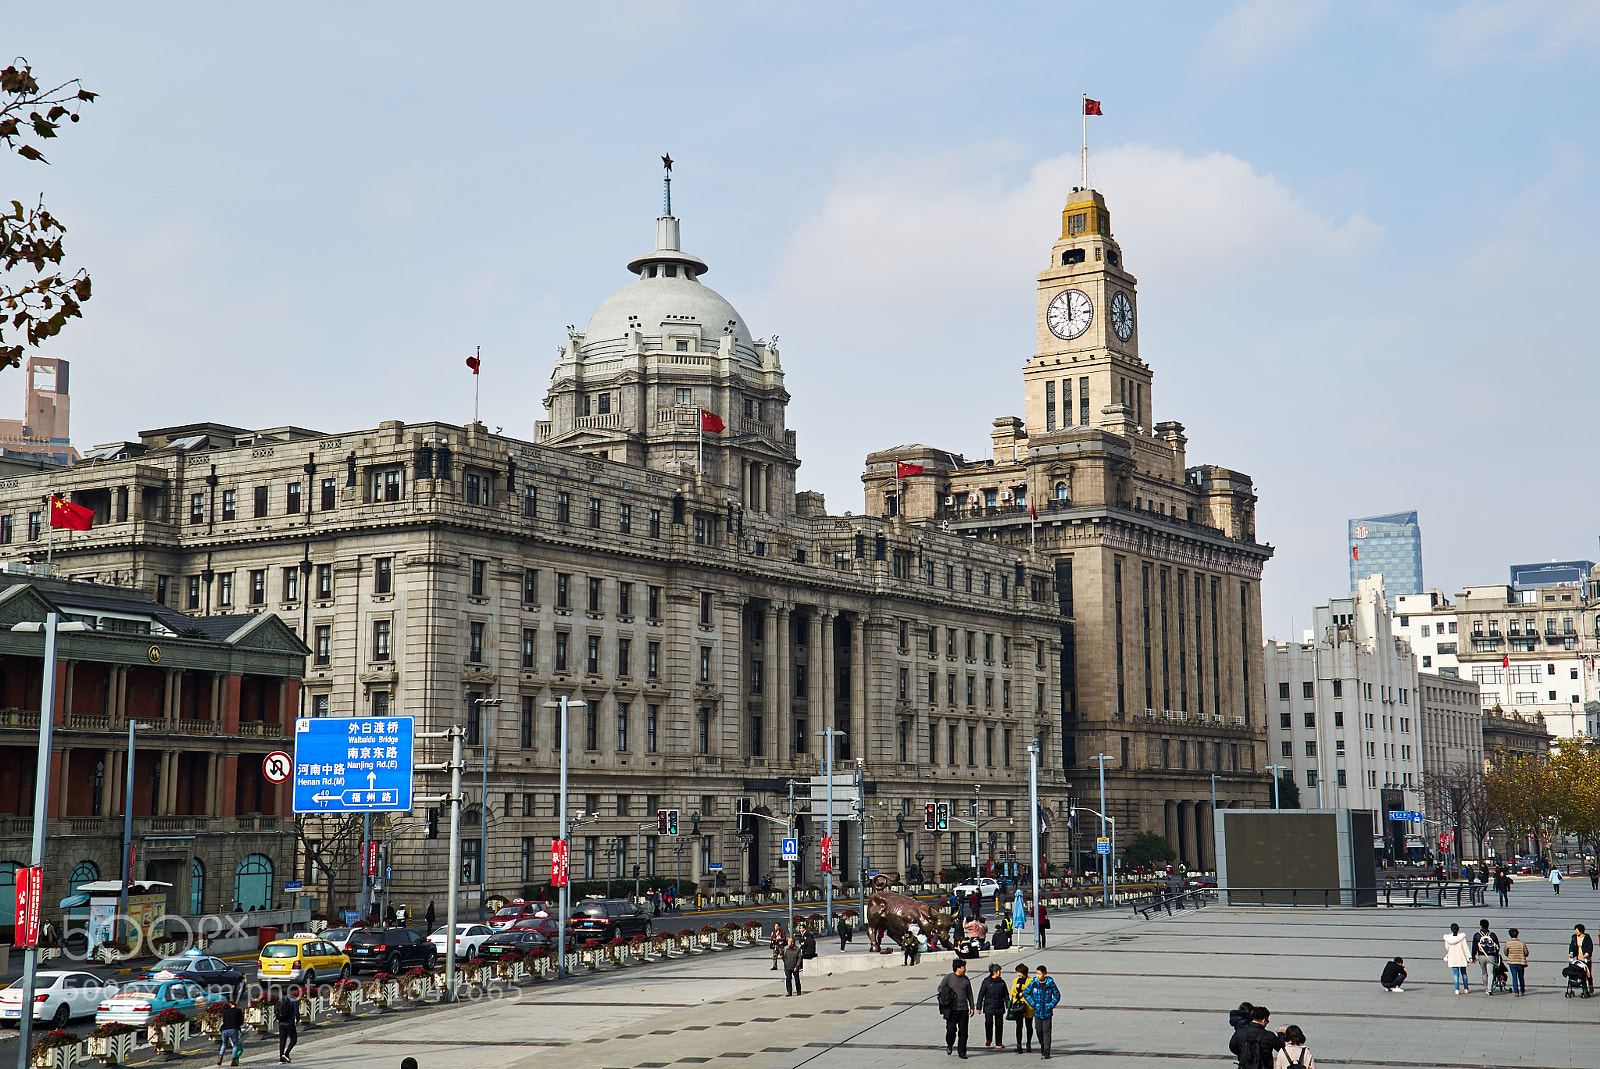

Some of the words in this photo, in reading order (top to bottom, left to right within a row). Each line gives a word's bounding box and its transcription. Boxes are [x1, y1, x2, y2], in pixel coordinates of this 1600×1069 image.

[348, 721, 399, 734] 外白渡桥
[348, 736, 376, 744] Waibaidu
[378, 735, 399, 744] Bridge
[347, 746, 398, 760] 南京东路
[297, 763, 345, 775] 河南中路
[347, 761, 374, 770] Nanjing
[376, 760, 398, 769] Rd.(E)
[297, 778, 321, 786] Henan
[322, 777, 345, 786] Rd.(M)
[351, 792, 392, 803] 福州路
[17, 890, 26, 925] 公正
